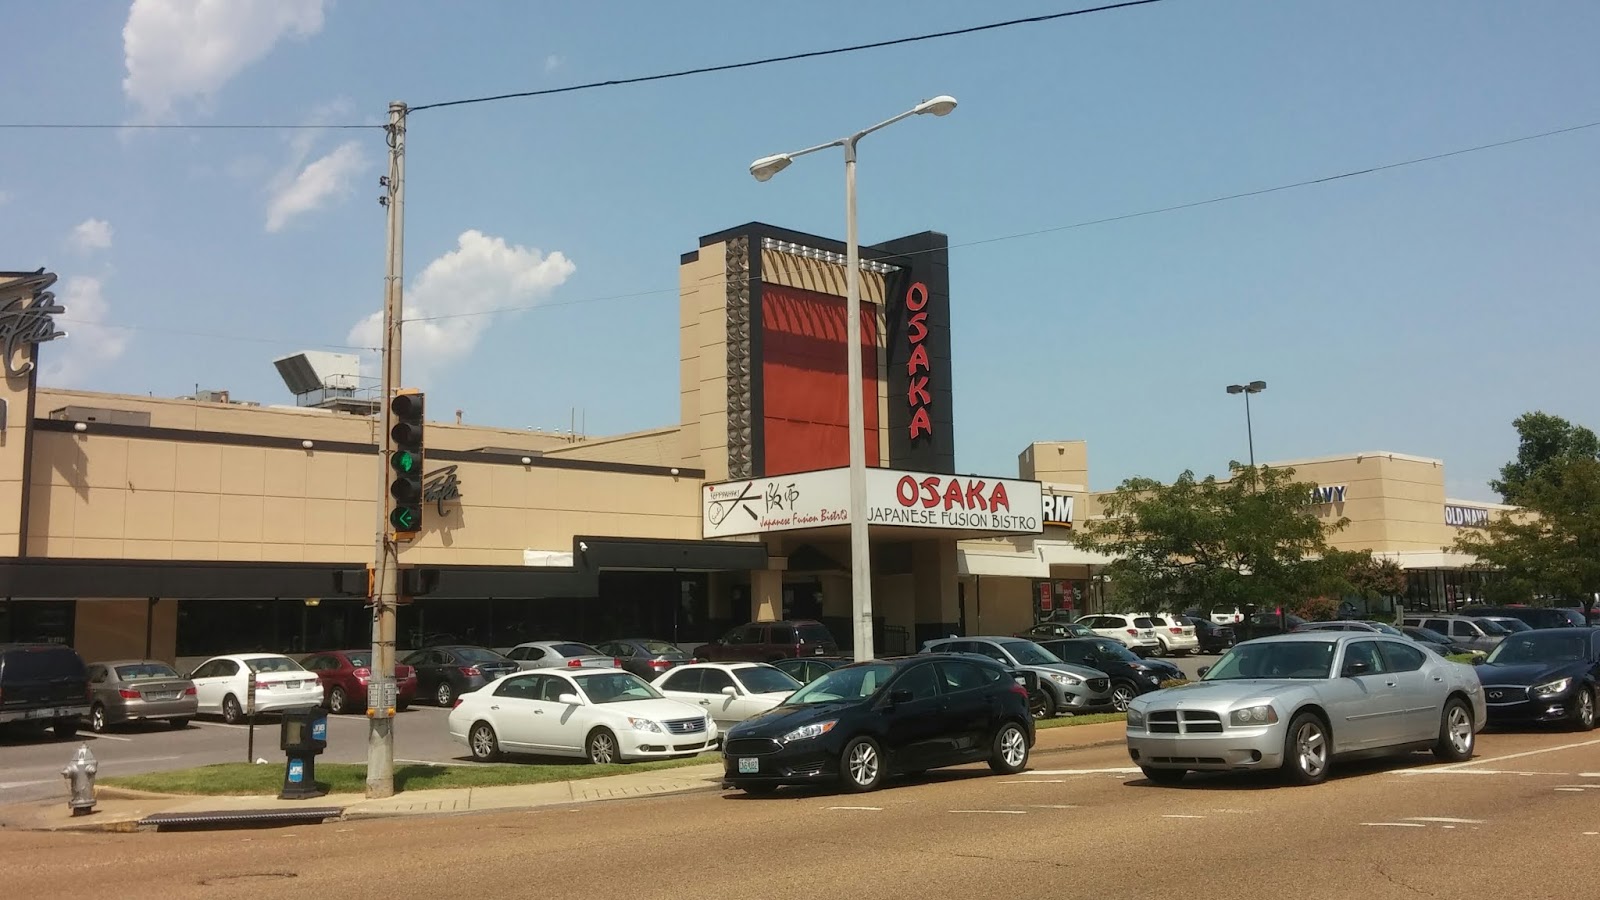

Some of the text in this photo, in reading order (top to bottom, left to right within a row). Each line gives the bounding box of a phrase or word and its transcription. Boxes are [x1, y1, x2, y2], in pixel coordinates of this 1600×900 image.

[905, 281, 932, 440] OSAKA
[896, 475, 1010, 514] OSAKA
[1309, 485, 1346, 504] AVY
[760, 516, 790, 530] Japanese
[792, 512, 818, 525] Fusion
[867, 507, 1036, 530] JAPANESE FUSION BISTRO
[1445, 506, 1487, 526] OLD NAVY
